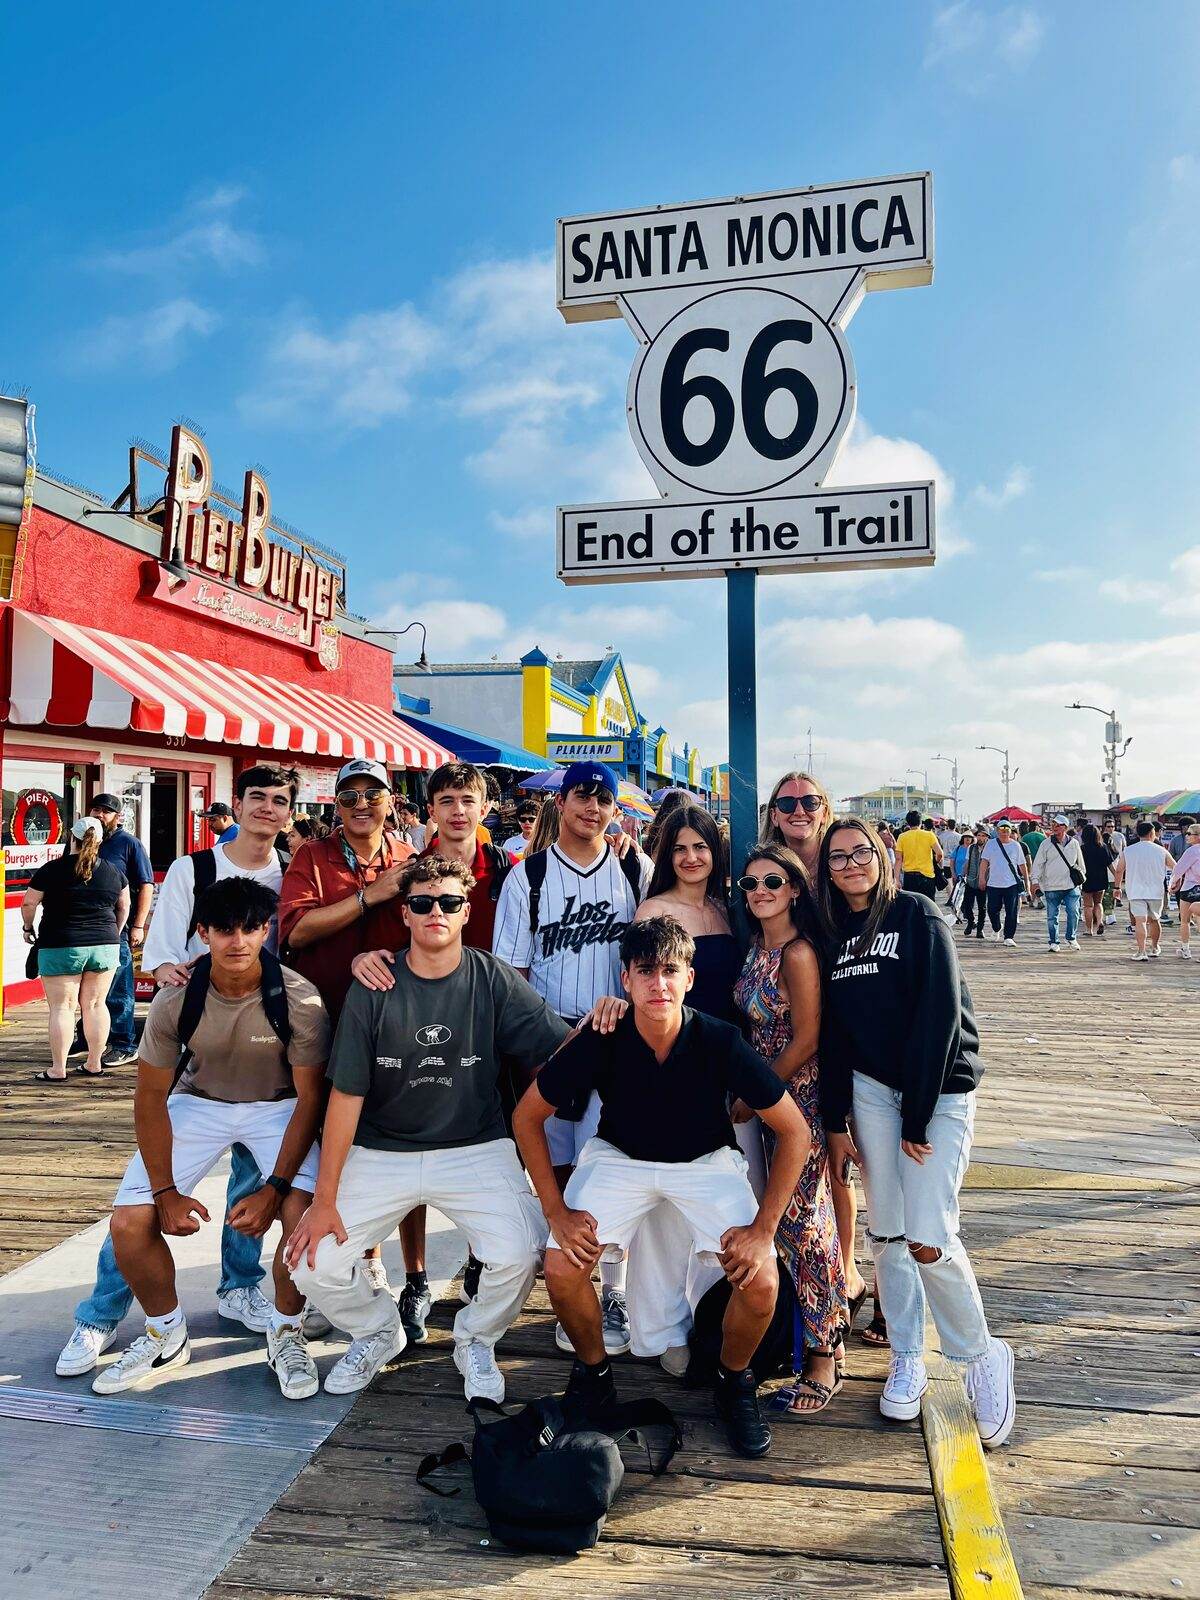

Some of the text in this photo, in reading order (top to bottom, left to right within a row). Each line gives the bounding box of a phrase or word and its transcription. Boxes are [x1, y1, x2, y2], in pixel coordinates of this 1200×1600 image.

[571, 194, 915, 284] SANTA MONICA
[660, 318, 819, 467] 66
[164, 425, 341, 646] Pier Burger
[576, 495, 914, 562] End of the Trail
[556, 745, 612, 754] PLAYLAND
[26, 793, 49, 806] PIER
[4, 849, 38, 867] Burgers
[560, 894, 611, 927] Los
[538, 911, 632, 961] Angele
[831, 962, 880, 980] CALIFORNIA
